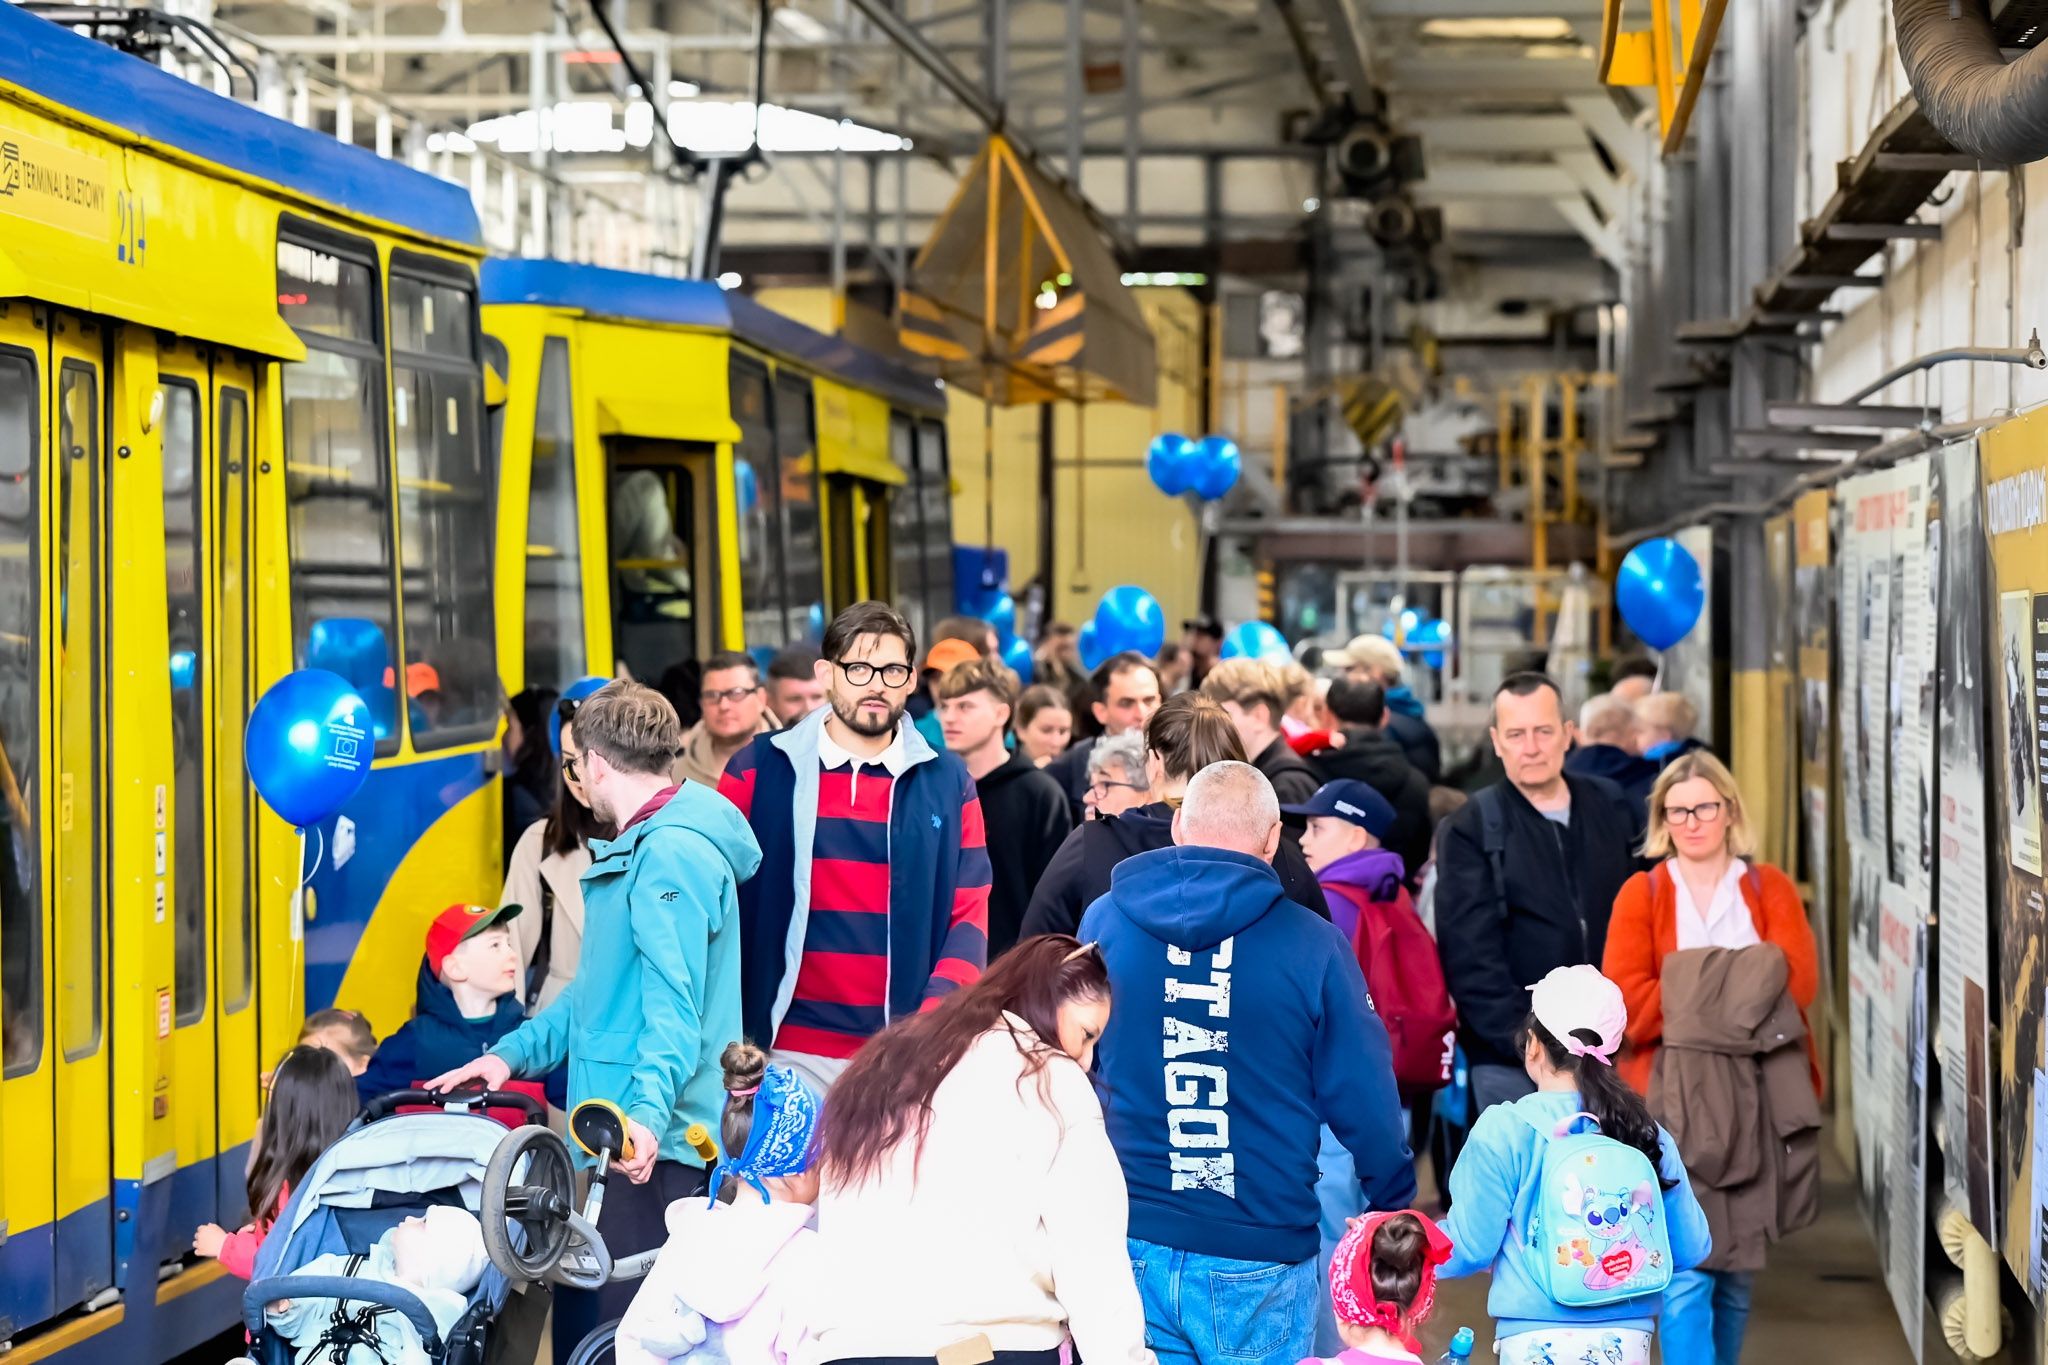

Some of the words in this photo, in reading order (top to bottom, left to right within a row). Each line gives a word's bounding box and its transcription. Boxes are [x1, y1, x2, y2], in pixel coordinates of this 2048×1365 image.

[22, 161, 64, 199] TERMINAL
[65, 174, 104, 213] BILETOWY
[1440, 1030, 1456, 1080] FILA
